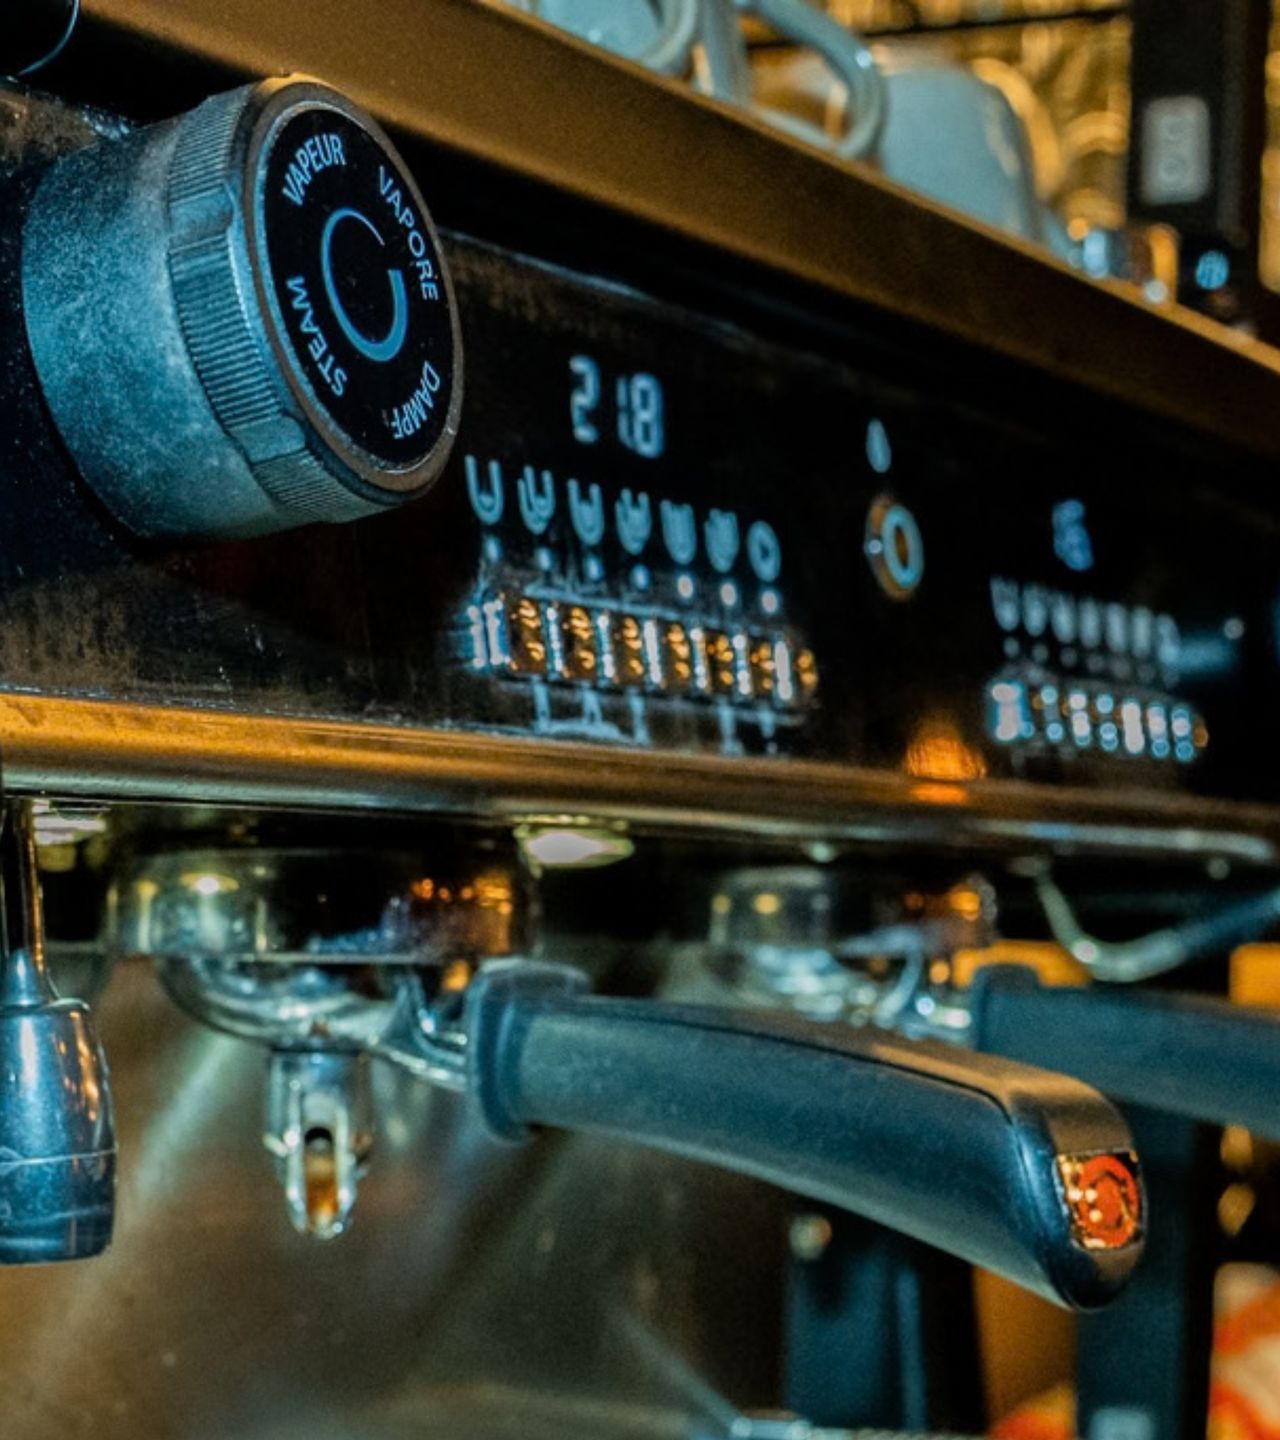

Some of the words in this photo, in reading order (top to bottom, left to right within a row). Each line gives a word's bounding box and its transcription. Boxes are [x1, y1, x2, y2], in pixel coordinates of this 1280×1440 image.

[282, 132, 346, 206] VAPEUR
[379, 165, 438, 301] VAPORE
[286, 276, 348, 397] STEAM
[391, 360, 441, 440] DAMPF
